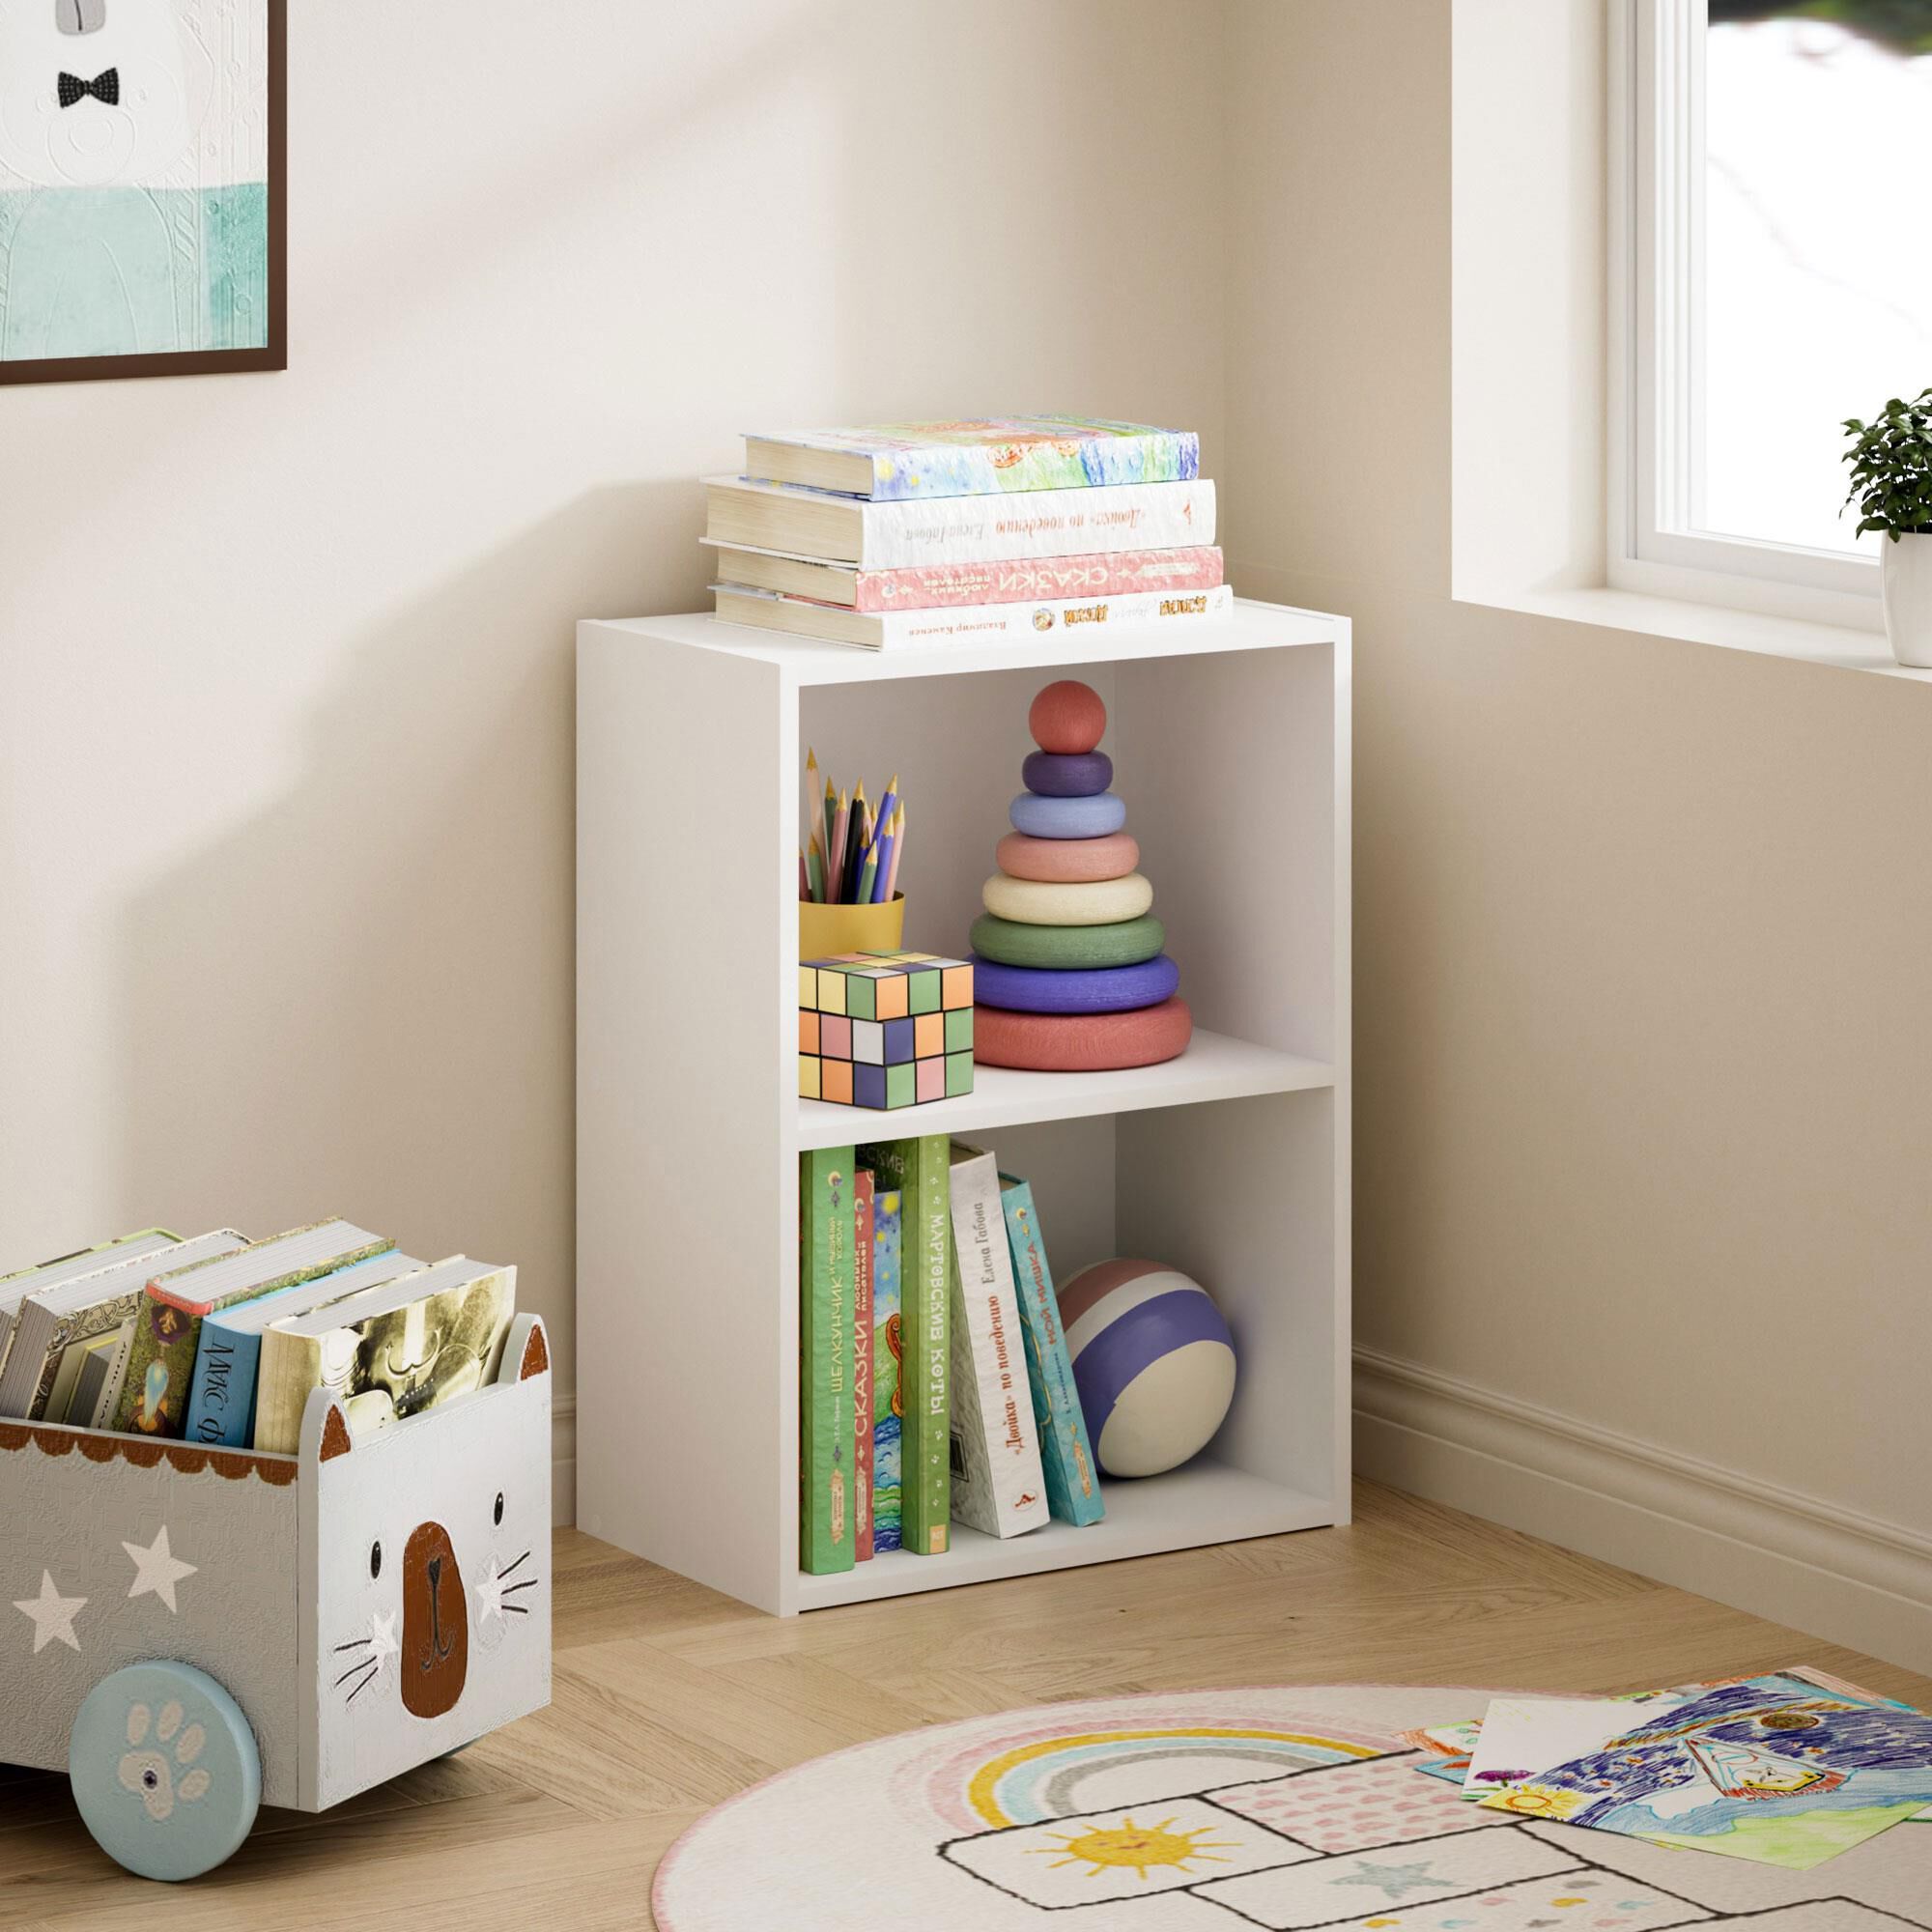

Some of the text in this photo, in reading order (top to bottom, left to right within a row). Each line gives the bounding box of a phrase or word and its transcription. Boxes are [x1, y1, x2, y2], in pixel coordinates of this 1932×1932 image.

[996, 516, 1064, 538] поведению
[1068, 510, 1084, 526] по
[999, 566, 1109, 591] СКАЗКИ
[831, 1276, 843, 1392] ЩЕЛКУНЧИК
[929, 1214, 945, 1415] МАРТОВСКИЕ КОТЫ
[973, 1202, 1024, 1456] «Двойка» по поведению Елена Габова
[1028, 1240, 1057, 1346] МОЙ МИШКА
[197, 1418, 226, 1445] Ф
[854, 1321, 867, 1436] СКАЗКИ
